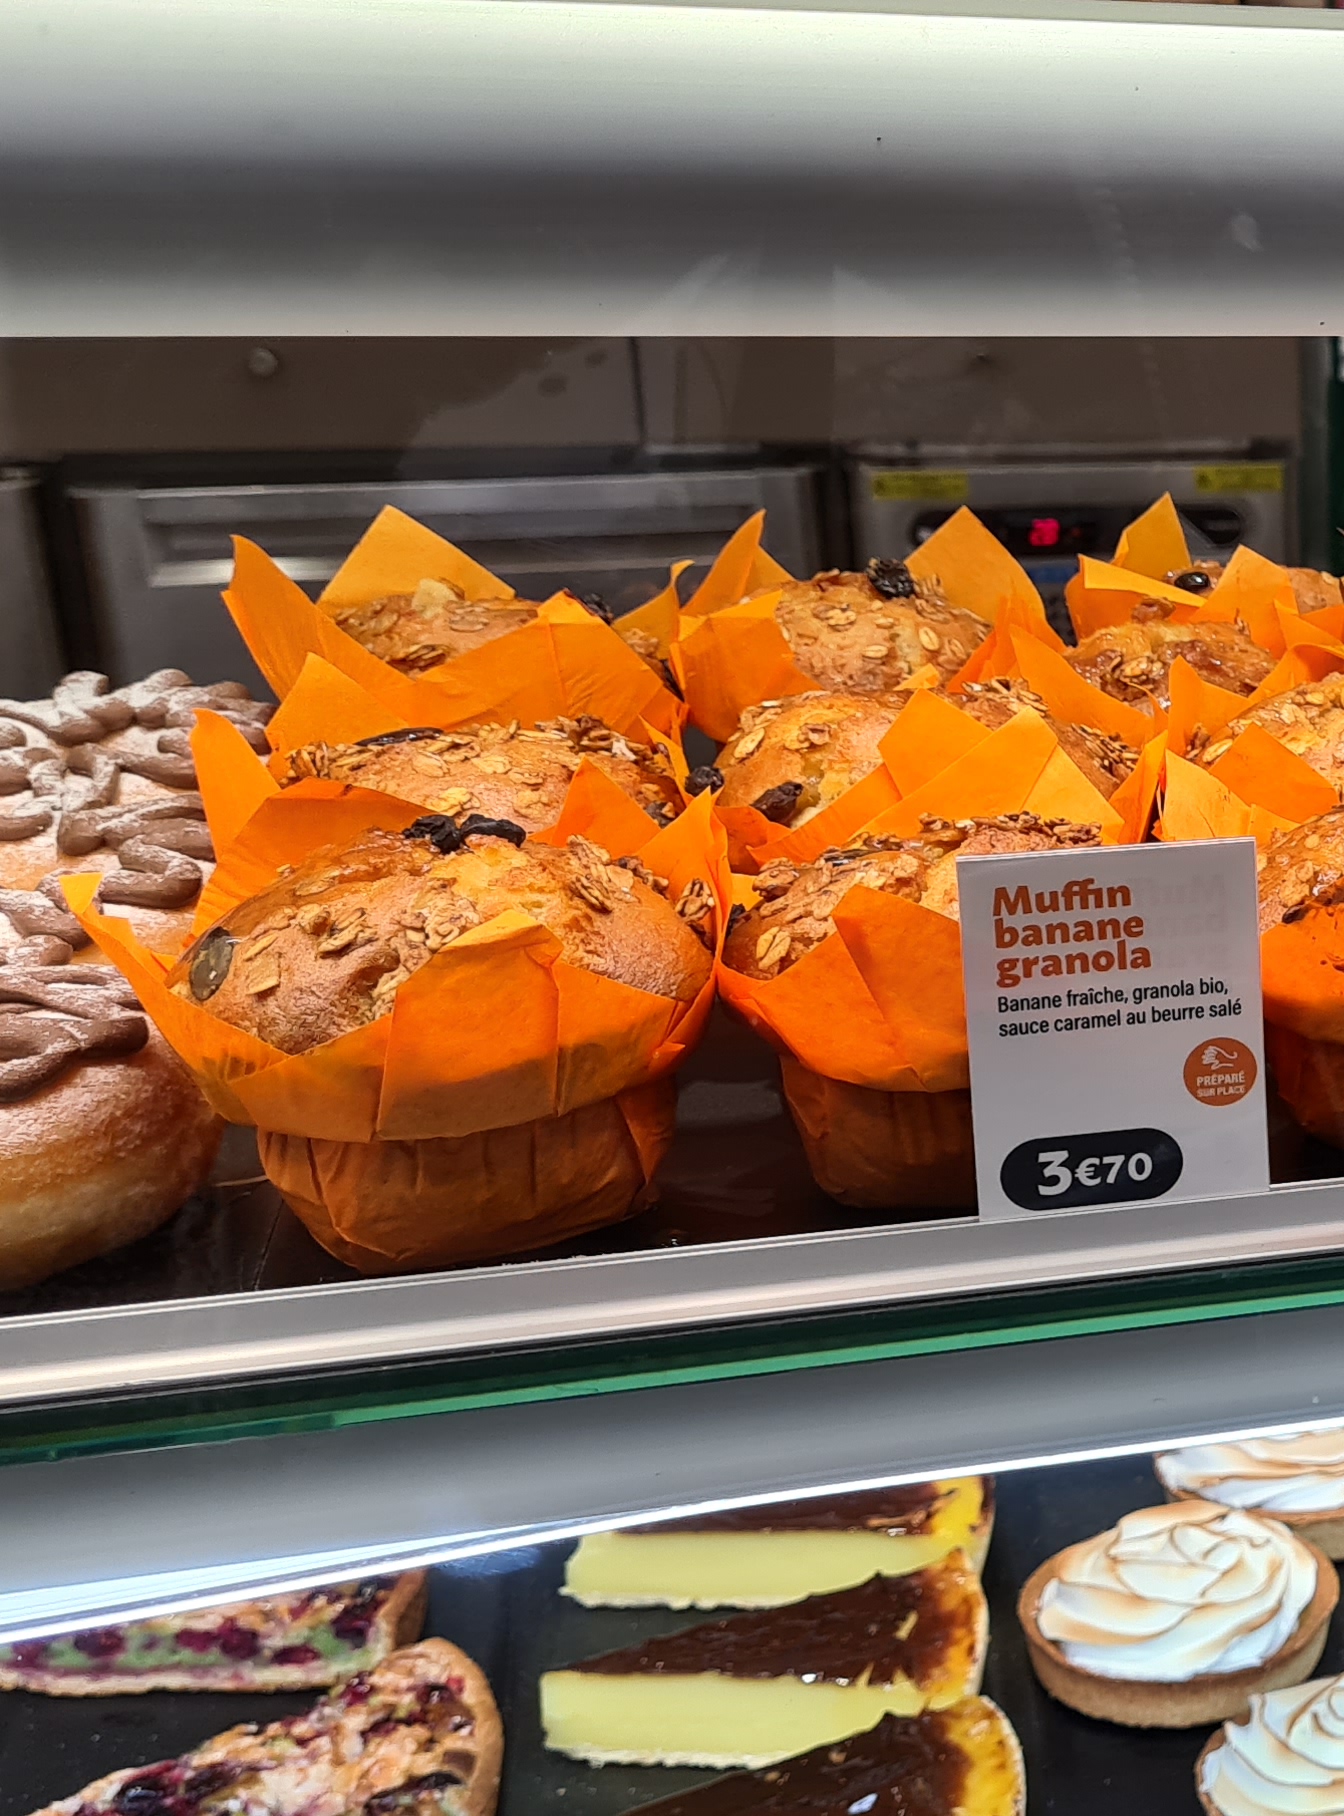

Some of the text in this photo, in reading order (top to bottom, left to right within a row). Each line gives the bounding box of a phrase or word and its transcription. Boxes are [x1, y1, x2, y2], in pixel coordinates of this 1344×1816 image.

[993, 878, 1132, 916] Muffin
[994, 915, 1144, 948] banane
[996, 940, 1151, 988] granola
[998, 977, 1228, 1013] Banane fraîche, granola bio,
[999, 998, 1242, 1037] sauce caramel au beurre salé
[1037, 1150, 1153, 1196] 3€70
